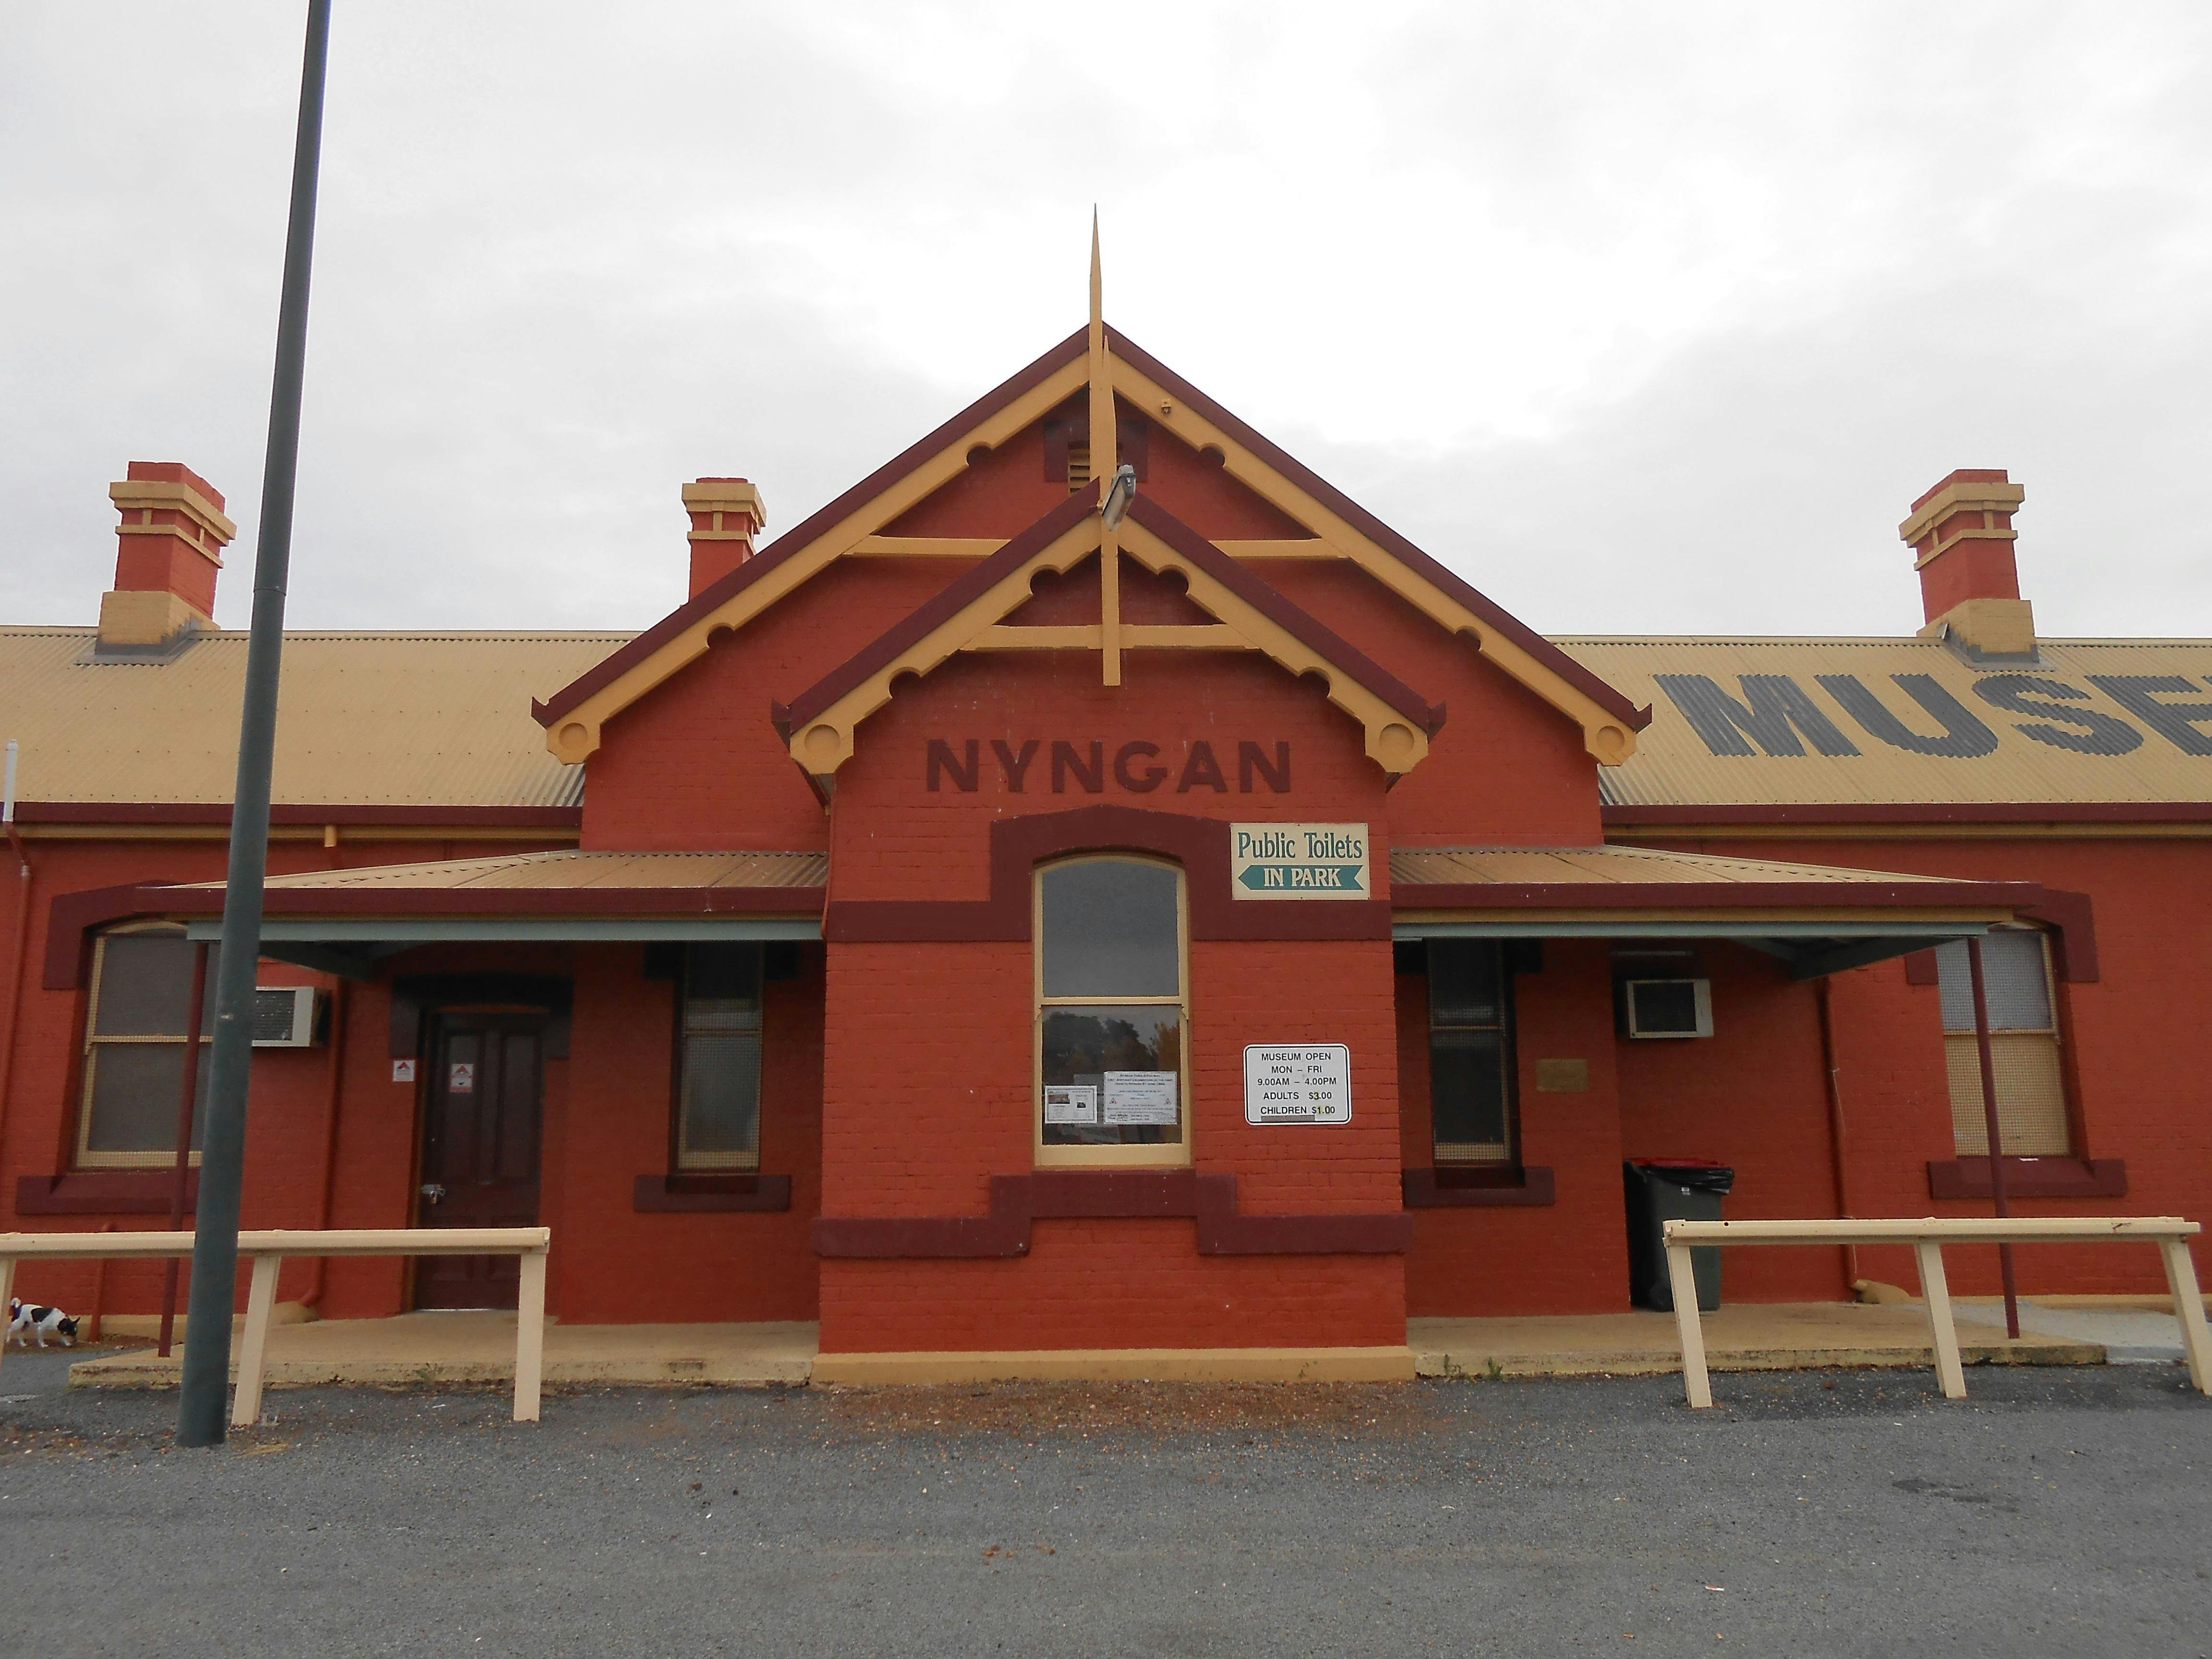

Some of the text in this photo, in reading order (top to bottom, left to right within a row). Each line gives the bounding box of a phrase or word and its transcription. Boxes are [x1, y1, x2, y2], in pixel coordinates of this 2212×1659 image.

[1652, 674, 2212, 757] MUSE
[927, 739, 1290, 793] NYNGAN
[1238, 832, 1362, 858] Public Toilets
[1263, 868, 1341, 887] IN PARK
[1262, 1052, 1331, 1061] MUSEUM OPEN
[1257, 1078, 1289, 1086] 9.00AM
[1305, 1077, 1336, 1085] 4.00PM
[1263, 1092, 1332, 1100] ADULTS $3.00
[1260, 1106, 1335, 1115] CHILDREN $1.00
